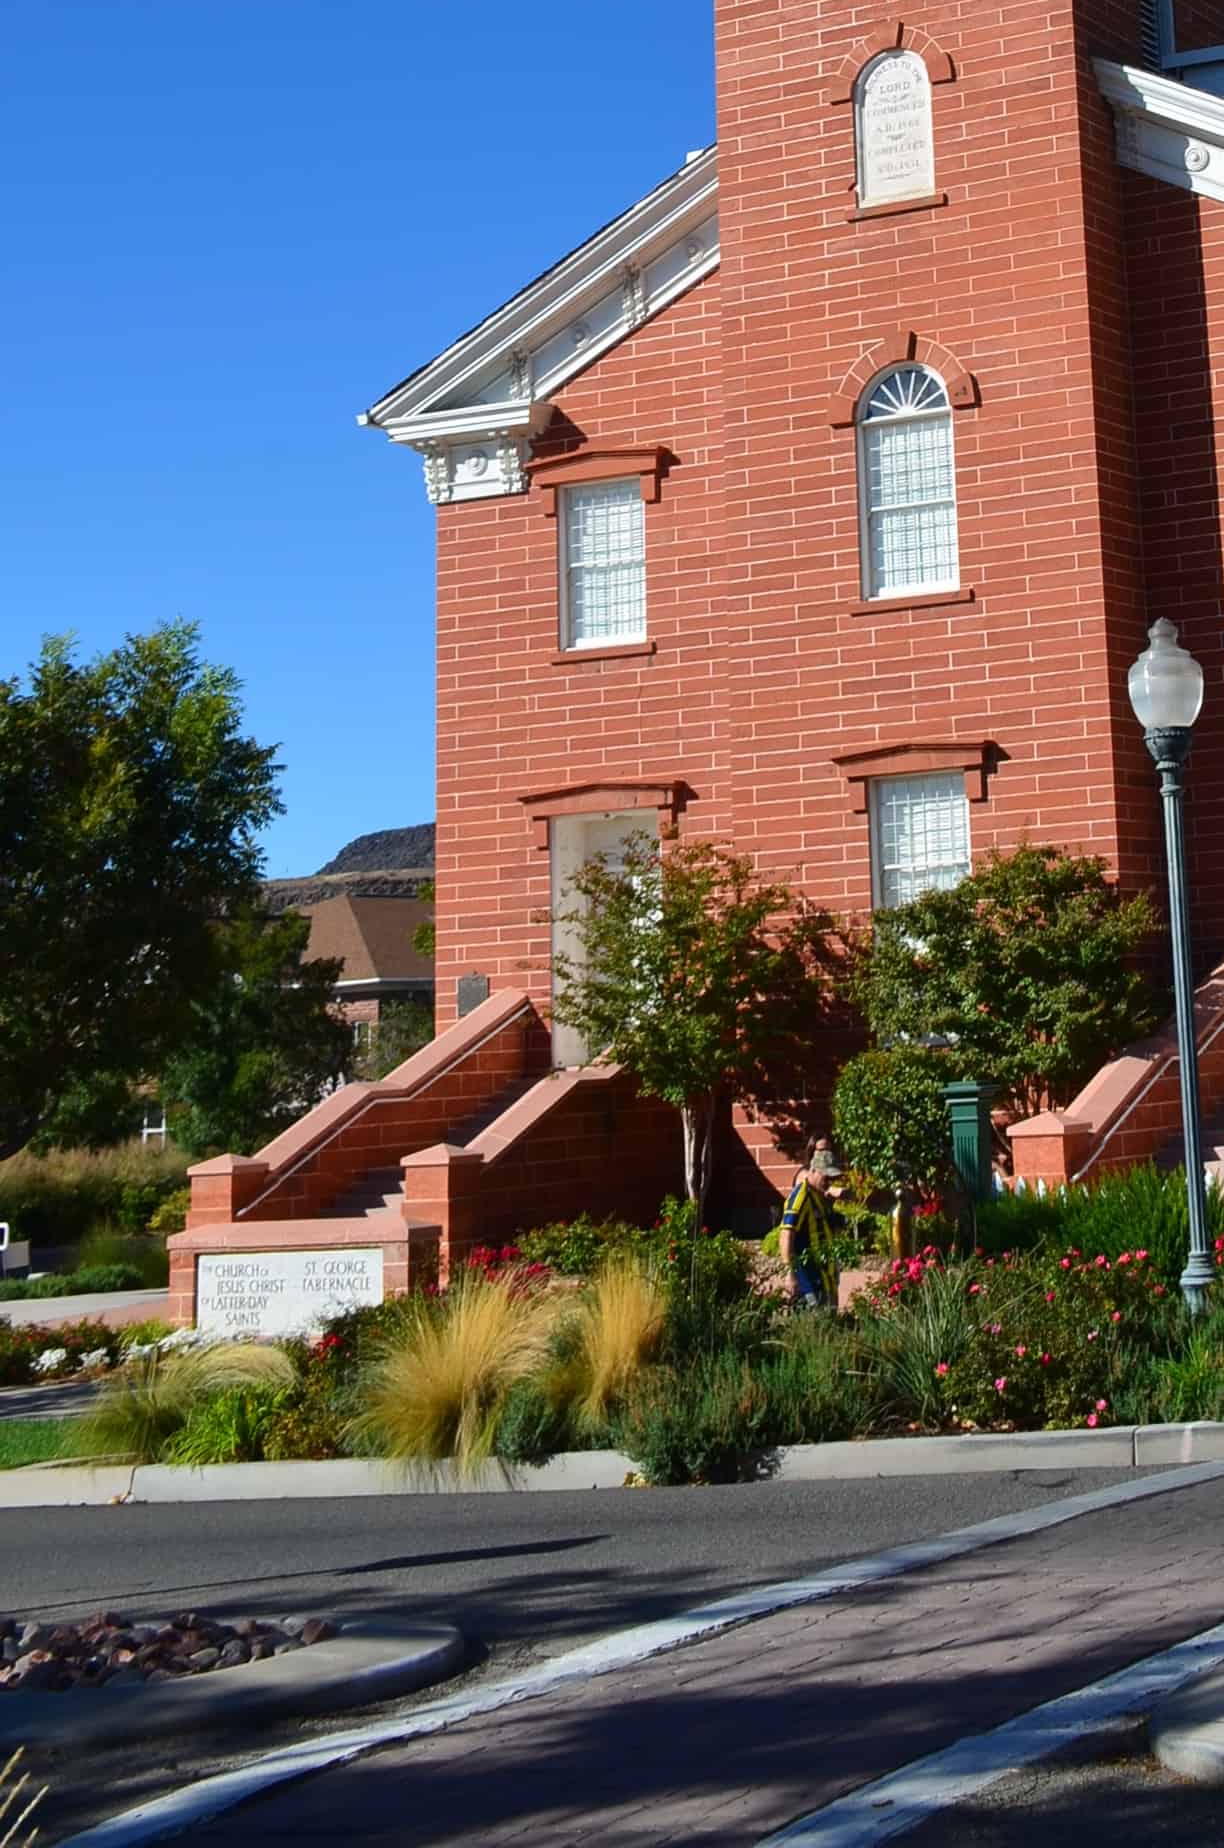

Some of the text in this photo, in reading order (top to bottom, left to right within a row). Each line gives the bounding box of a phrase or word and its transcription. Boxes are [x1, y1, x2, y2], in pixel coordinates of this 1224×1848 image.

[879, 81, 911, 95] LORD
[215, 1263, 259, 1278] CHURCH
[324, 1260, 367, 1275] GEORGE
[217, 1279, 286, 1294] JESUS CHRIST
[303, 1277, 372, 1292] TABERNACLE
[225, 1312, 260, 1326] SAINTS
